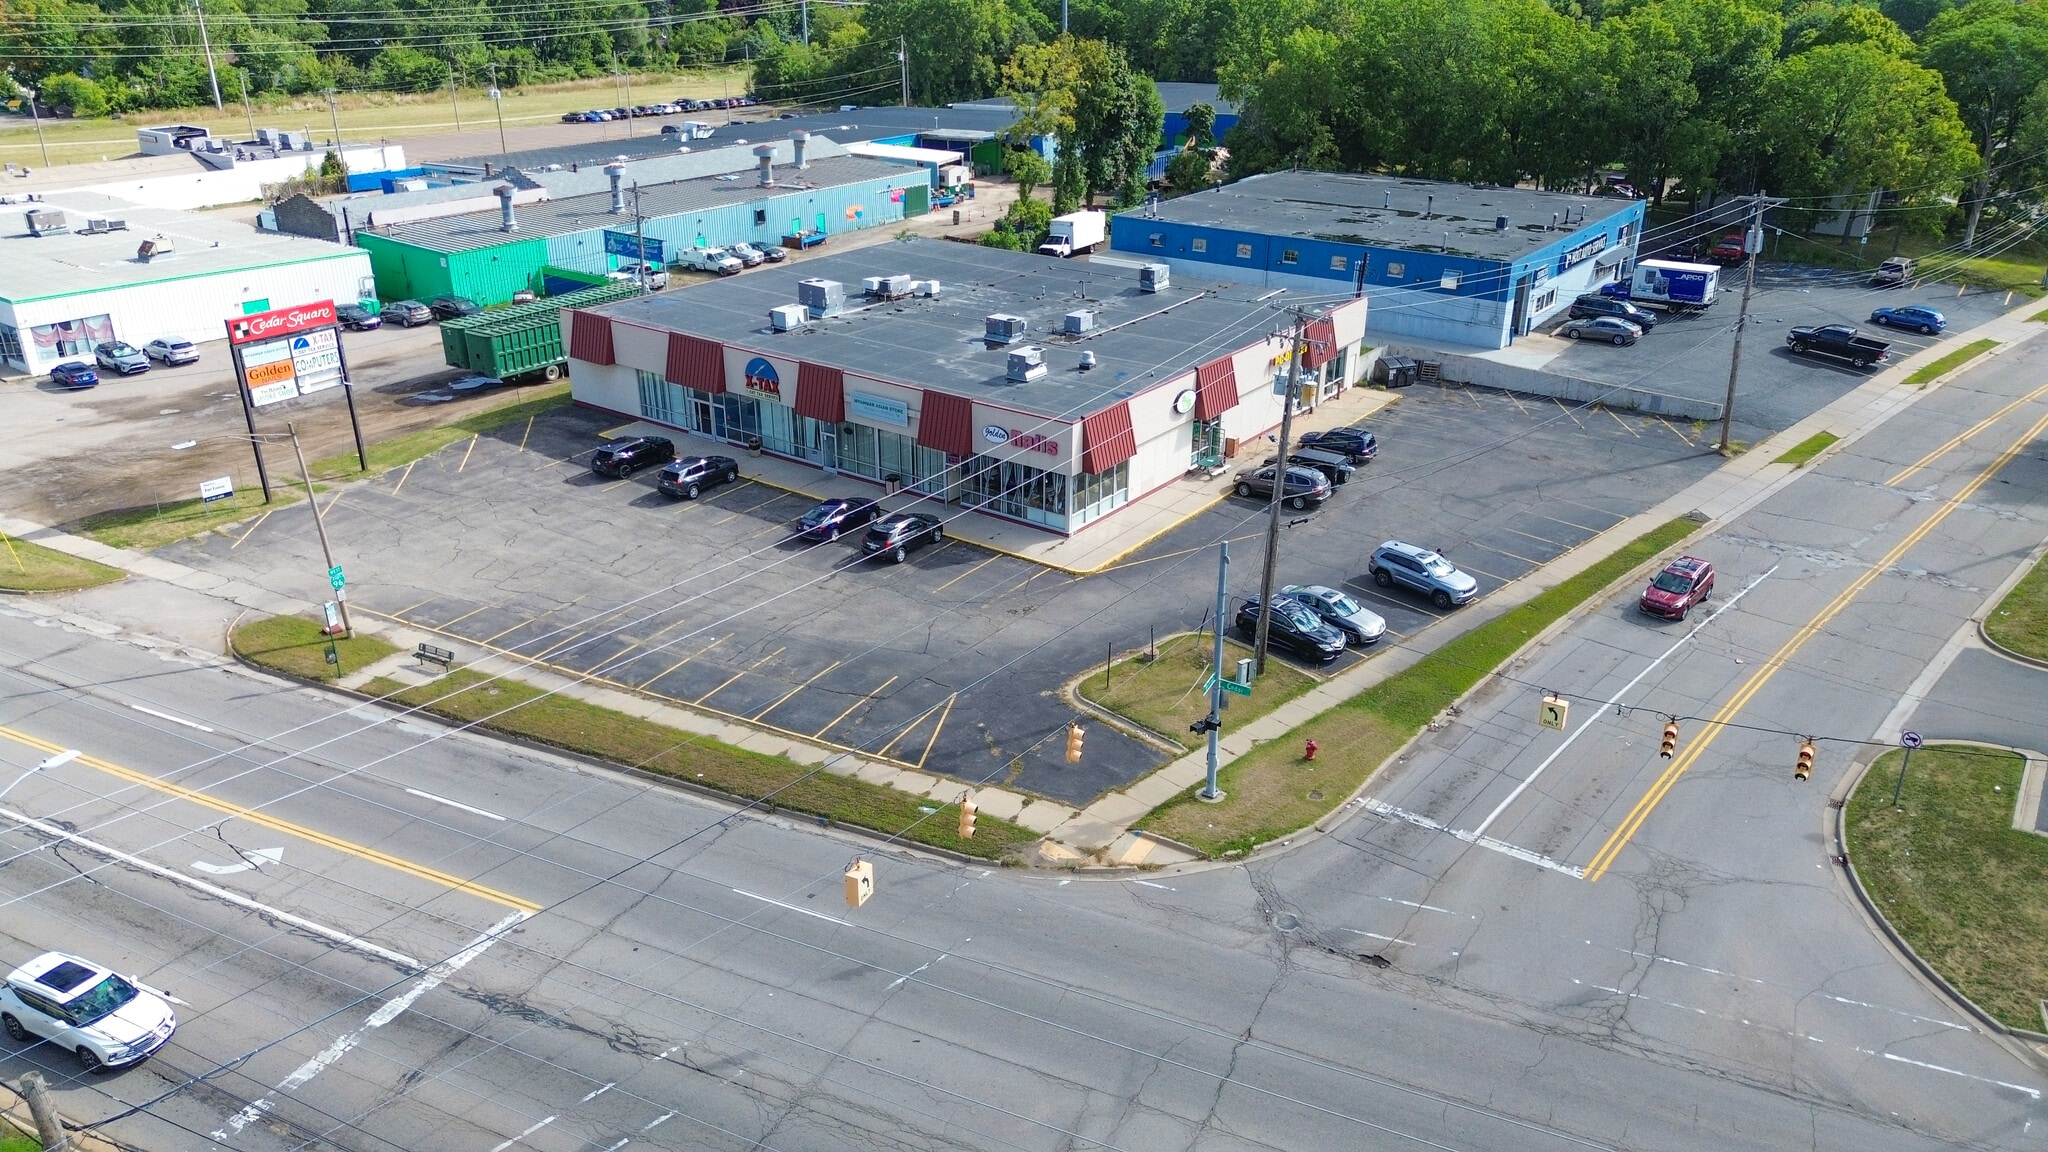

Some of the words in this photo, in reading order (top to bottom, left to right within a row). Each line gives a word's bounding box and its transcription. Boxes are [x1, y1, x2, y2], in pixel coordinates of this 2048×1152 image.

[1679, 273, 1704, 281] APCO
[250, 315, 287, 335] Cedar
[286, 307, 332, 328] Square
[312, 331, 334, 345] X-TAX
[295, 351, 339, 372] COMPUTERS
[249, 363, 291, 380] Golden
[261, 375, 282, 384] NAILS
[745, 374, 780, 395] X-TAX
[278, 388, 295, 399] SHOP
[332, 580, 344, 588] 96
[1542, 719, 1560, 728] ONLY
